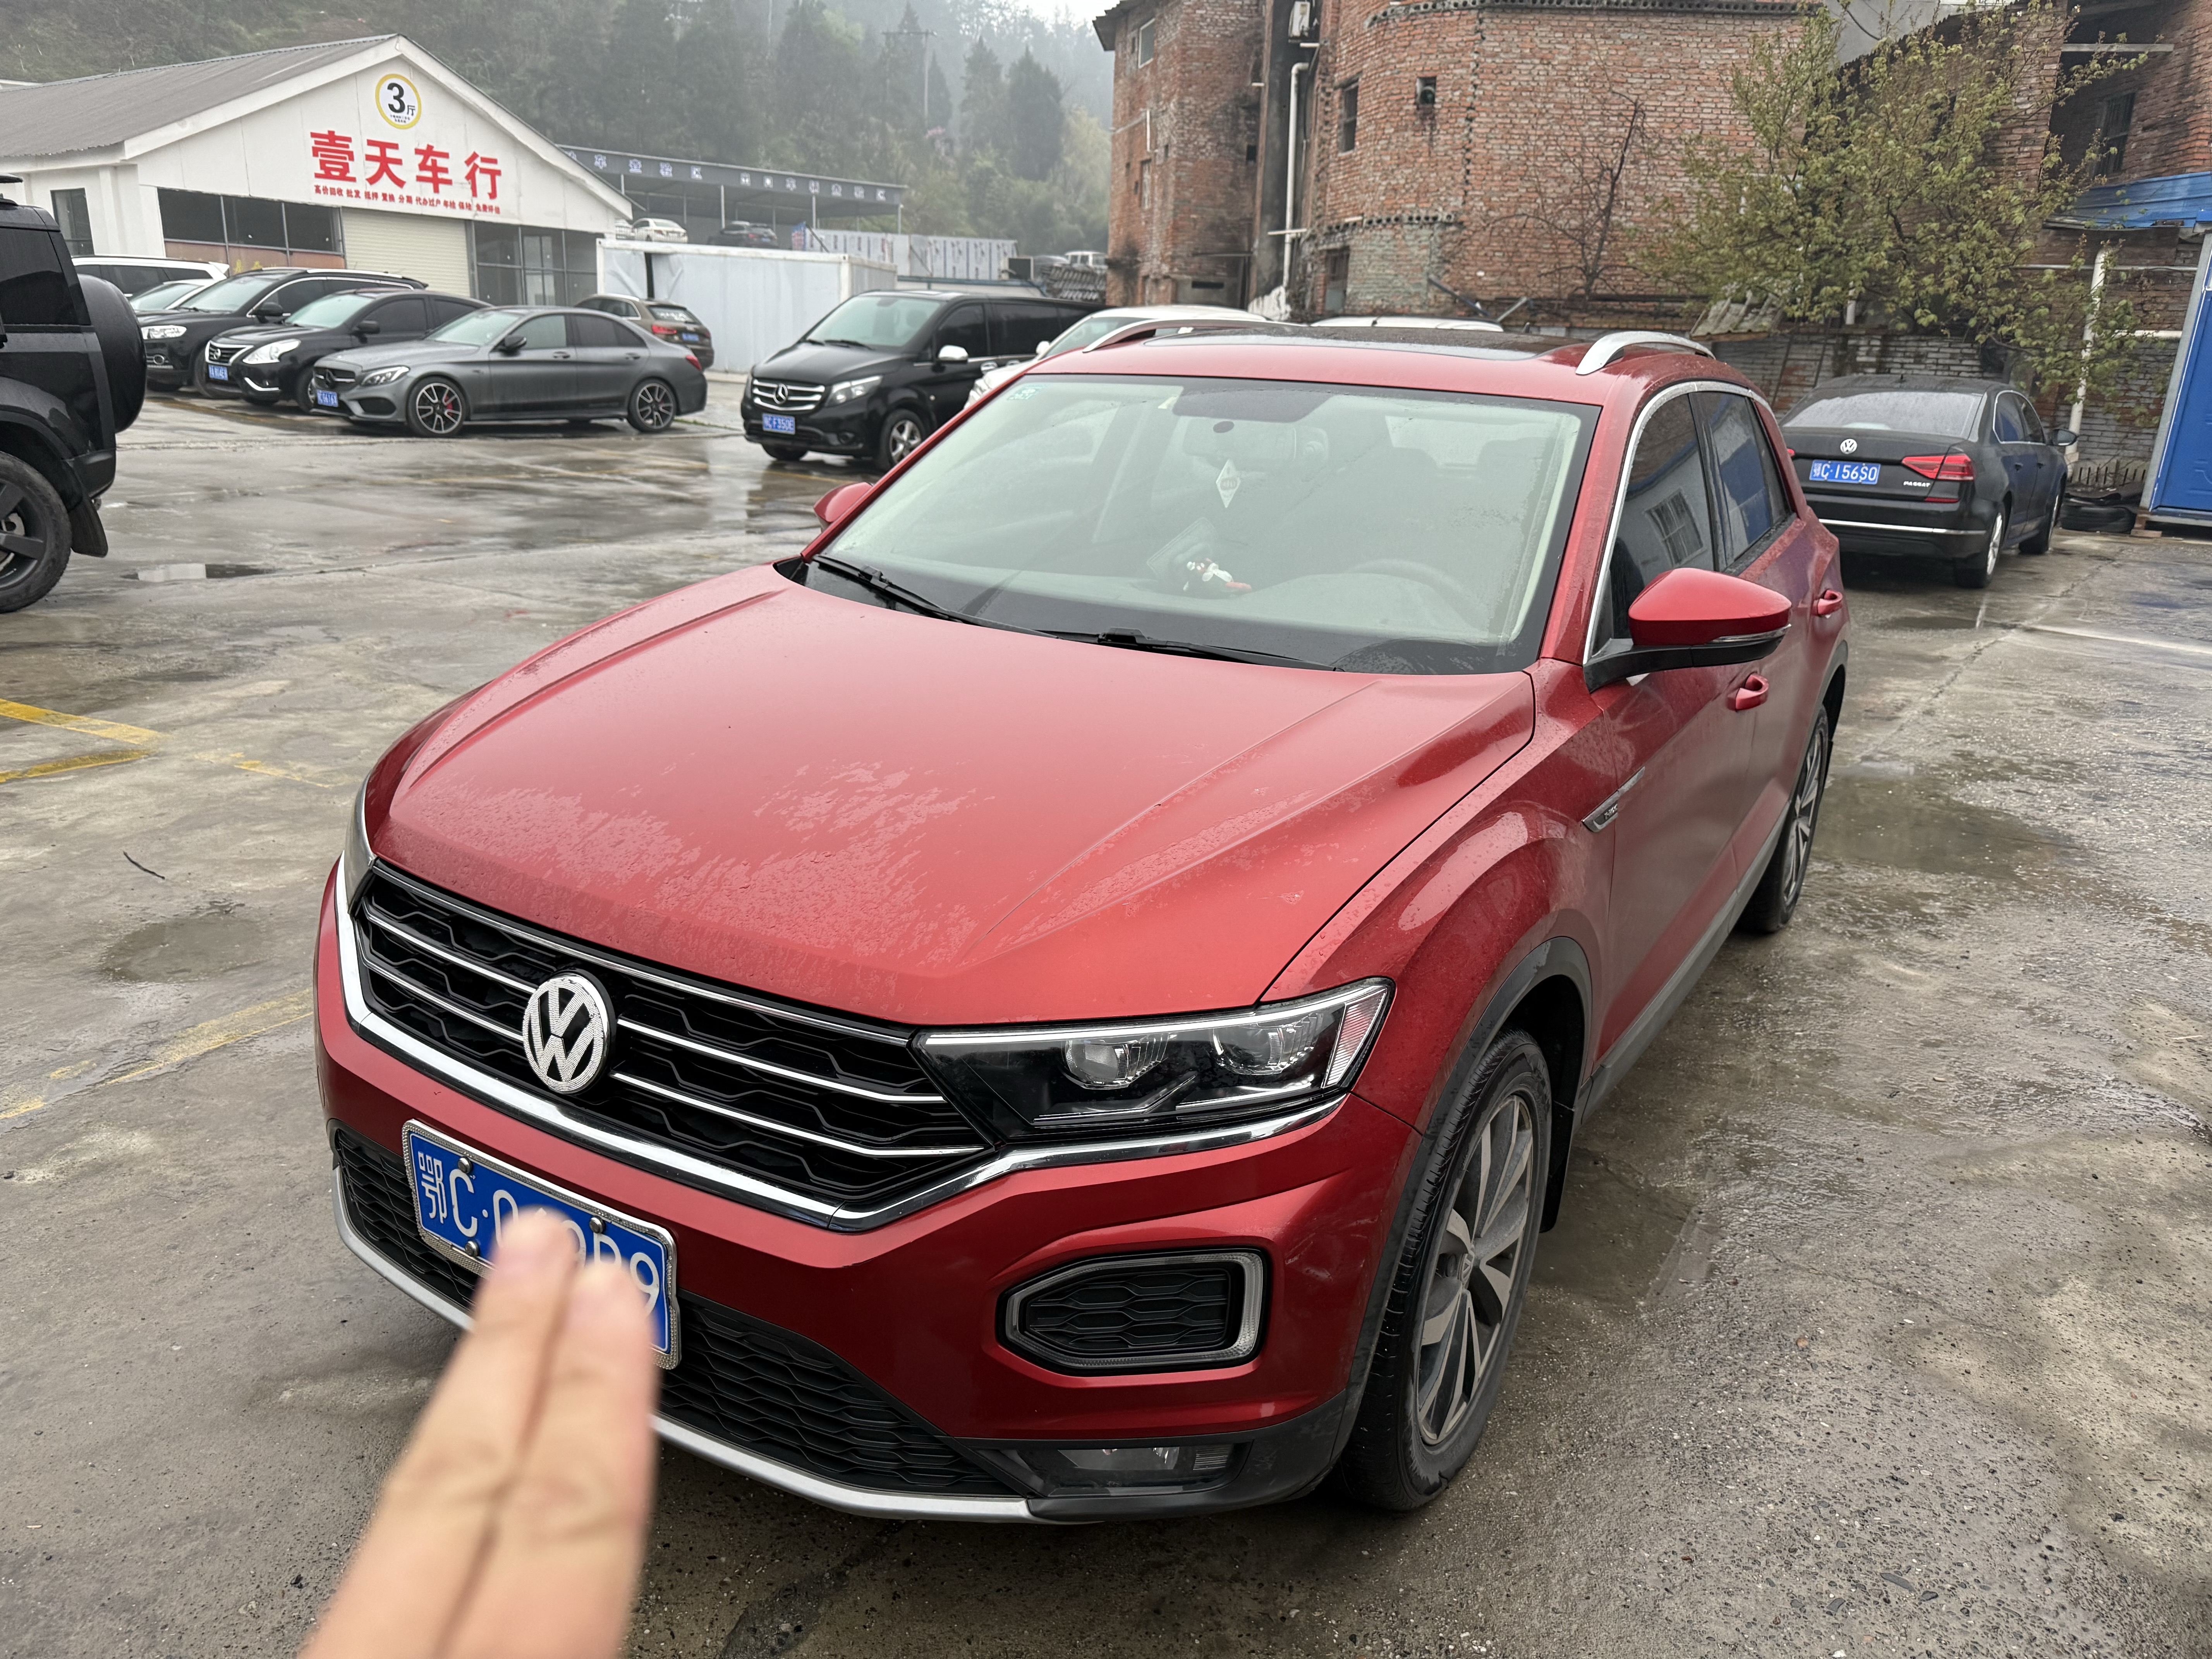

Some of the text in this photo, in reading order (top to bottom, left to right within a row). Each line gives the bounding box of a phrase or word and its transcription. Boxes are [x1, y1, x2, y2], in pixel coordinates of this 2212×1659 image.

[310, 130, 501, 200] 壹天车行
[314, 185, 343, 196] 高价回收
